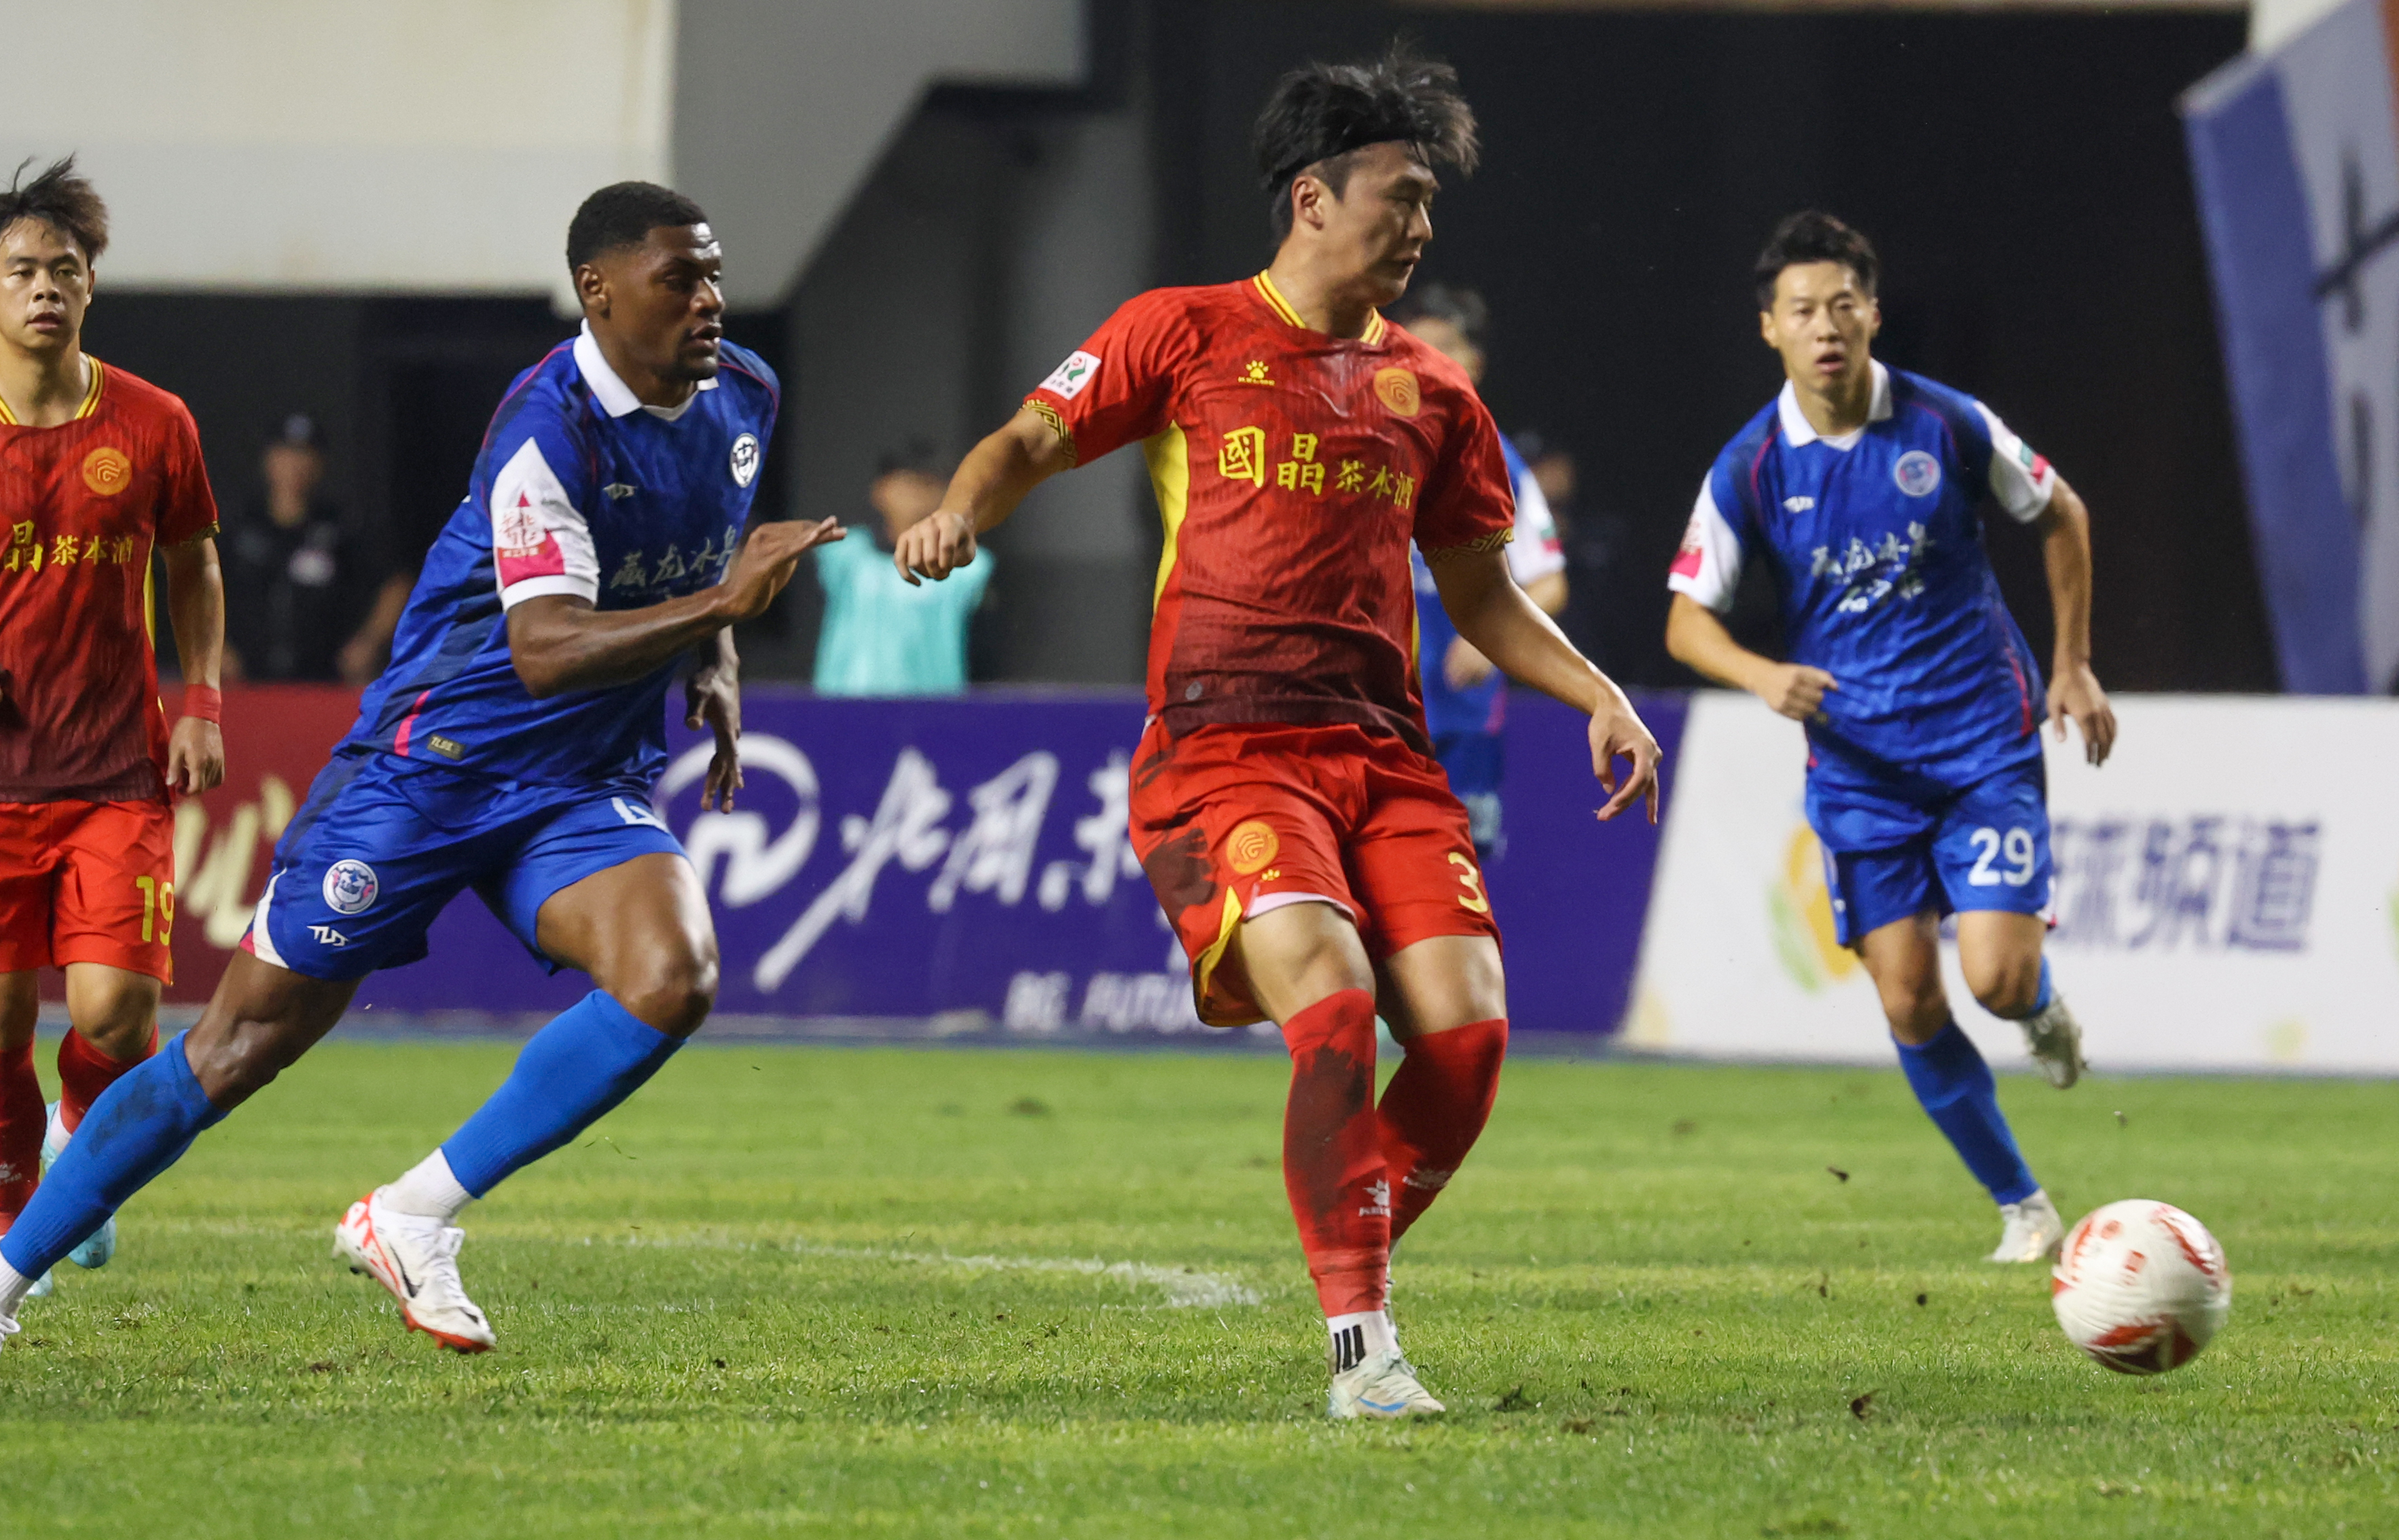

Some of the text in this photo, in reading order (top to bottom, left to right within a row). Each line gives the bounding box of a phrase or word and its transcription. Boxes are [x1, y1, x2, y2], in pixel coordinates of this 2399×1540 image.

[1447, 851, 1489, 913] 3
[1968, 827, 2036, 887] 29
[137, 875, 175, 946] 19
